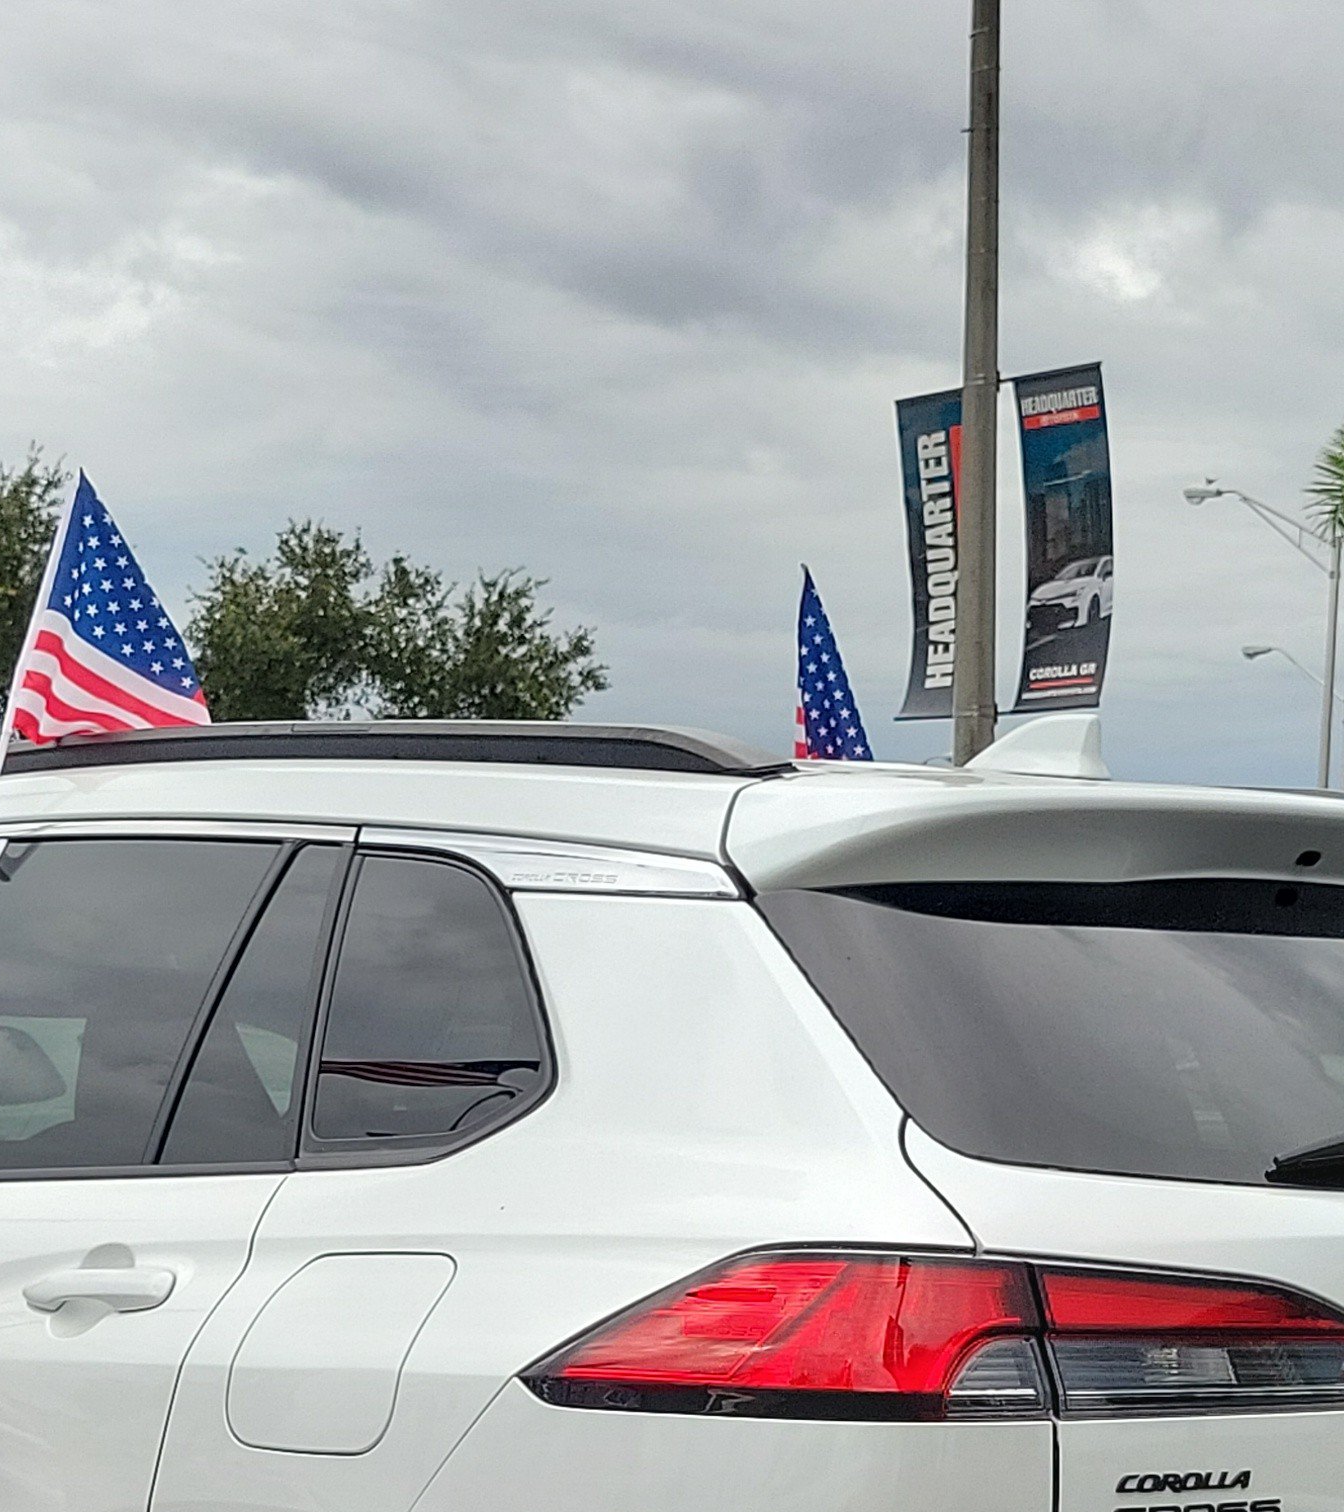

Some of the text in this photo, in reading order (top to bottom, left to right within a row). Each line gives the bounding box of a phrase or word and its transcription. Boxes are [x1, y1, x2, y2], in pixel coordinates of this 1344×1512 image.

[1021, 387, 1099, 416] HEADQUARTER
[916, 430, 959, 690] HEADQUARTER
[1029, 664, 1078, 681] COROLLA
[1115, 1470, 1252, 1494] COROLLA
